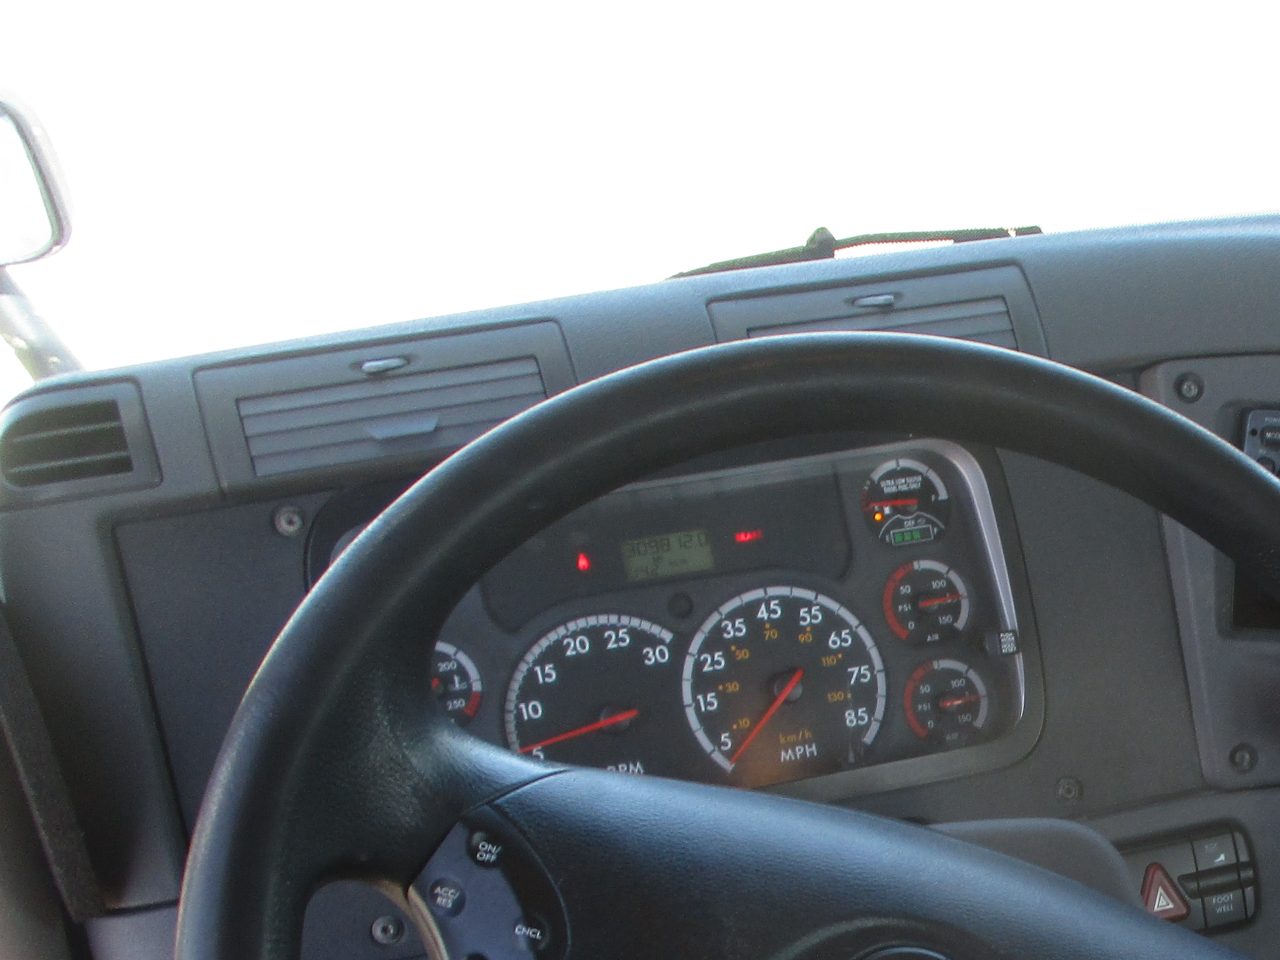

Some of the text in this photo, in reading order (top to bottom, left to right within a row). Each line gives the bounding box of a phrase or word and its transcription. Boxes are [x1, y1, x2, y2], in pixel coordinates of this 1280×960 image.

[931, 580, 946, 589] 100
[757, 600, 782, 620] 45
[799, 606, 822, 626] 55
[938, 614, 953, 624] 150
[721, 618, 746, 639] 35
[764, 629, 778, 640] 70
[563, 635, 590, 656] 20
[604, 628, 630, 649] 25
[828, 629, 852, 649] 65
[642, 645, 669, 666] 30
[700, 652, 725, 672] 25
[735, 649, 750, 660] 50
[438, 660, 457, 672] 200
[534, 664, 556, 685] 15
[847, 665, 871, 686] 75
[446, 698, 466, 711] 250
[518, 701, 542, 721] 10
[696, 692, 718, 712] 15
[844, 708, 868, 727] 85
[720, 732, 732, 750] 5
[779, 729, 812, 744] km/h
[532, 746, 544, 760] 5
[780, 743, 818, 763] MPH
[479, 841, 502, 854] ON/
[476, 852, 497, 864] OFF
[434, 886, 460, 899] ACC/
[1212, 893, 1233, 904] FOOT
[436, 896, 452, 908] RES
[515, 924, 542, 940] CNCL
